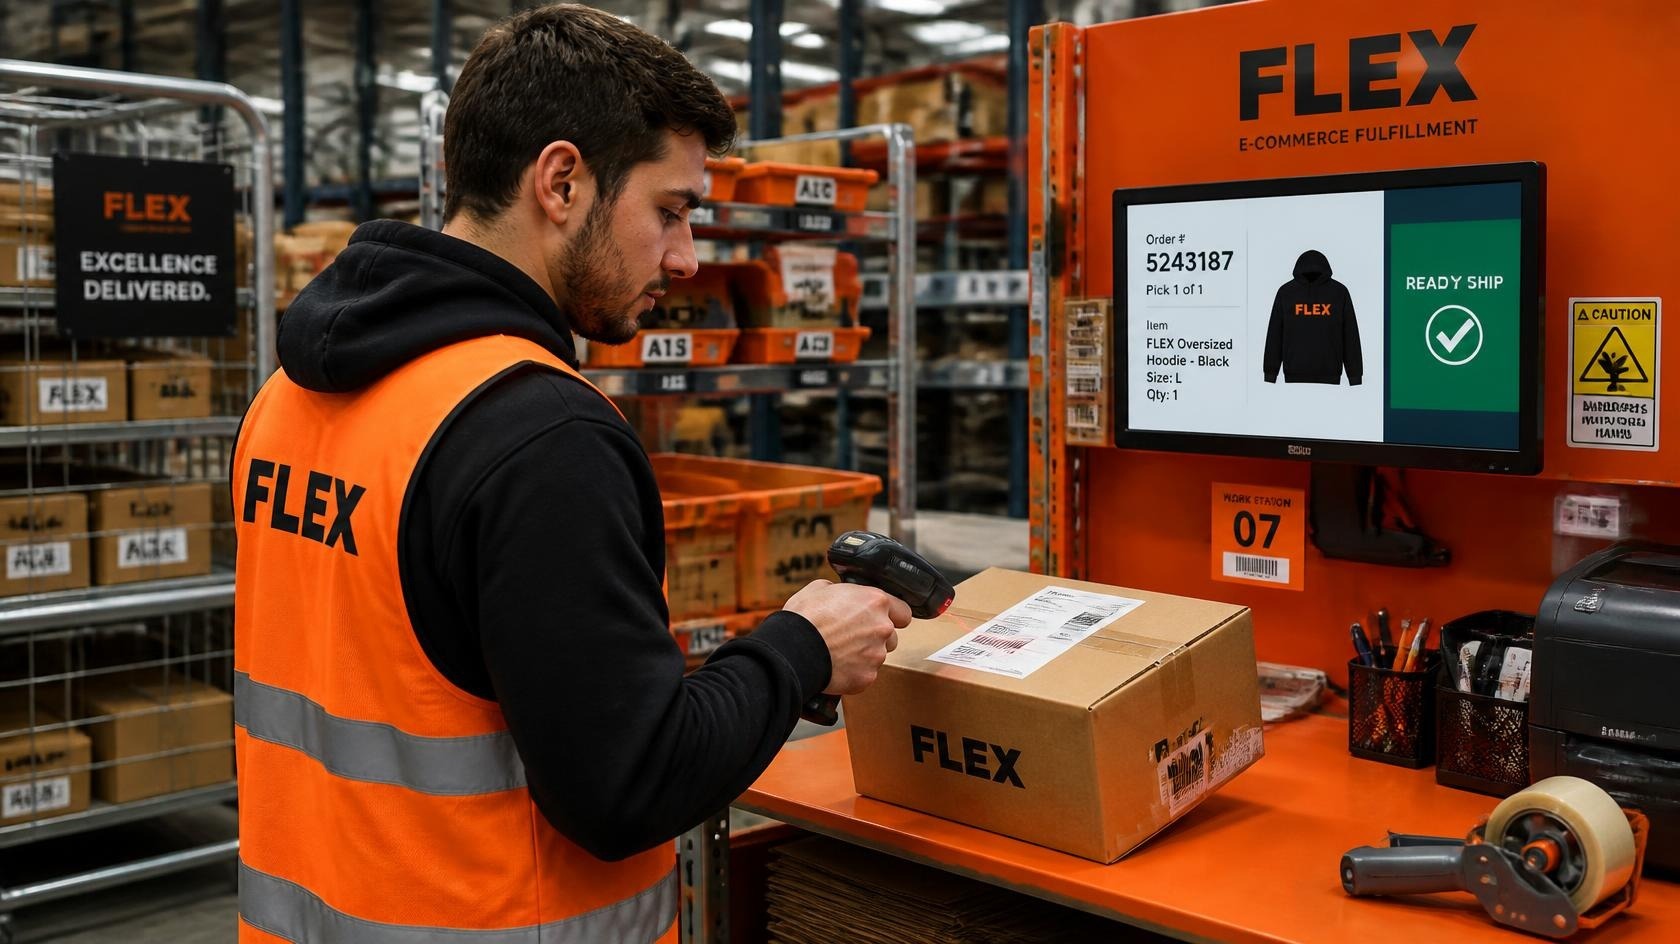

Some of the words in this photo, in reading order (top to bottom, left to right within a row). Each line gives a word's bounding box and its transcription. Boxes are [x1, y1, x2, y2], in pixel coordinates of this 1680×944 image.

[1239, 23, 1478, 121] FLEX
[1239, 129, 1349, 151] E-COMMERCE
[1355, 118, 1479, 142] FULFILLMENT
[103, 191, 192, 222] FLEX
[1146, 233, 1176, 245] Order
[80, 251, 218, 275] EXCELLENCE
[1146, 250, 1234, 272] 5243187
[83, 279, 212, 301] DELIVERED.
[1146, 284, 1170, 296] Pick
[1173, 284, 1179, 295] 1
[1183, 283, 1195, 295] of
[1198, 284, 1203, 295] 1
[1406, 275, 1462, 290] READY
[1467, 275, 1504, 289] SHIP
[1295, 303, 1331, 316] FLEX
[1592, 308, 1651, 321] CAUTION
[1146, 338, 1174, 349] FLEX
[1177, 338, 1233, 350] Oversized
[1146, 355, 1187, 366] Hoodie
[1198, 355, 1229, 367] Black
[1146, 371, 1173, 384] Size:
[1175, 372, 1182, 384] L
[49, 384, 102, 405] FLEX
[1146, 388, 1170, 403] Qty:
[1172, 389, 1178, 401] 1
[243, 458, 367, 556] FLEX
[1233, 510, 1281, 549] 07
[910, 724, 1026, 789] FLEX
